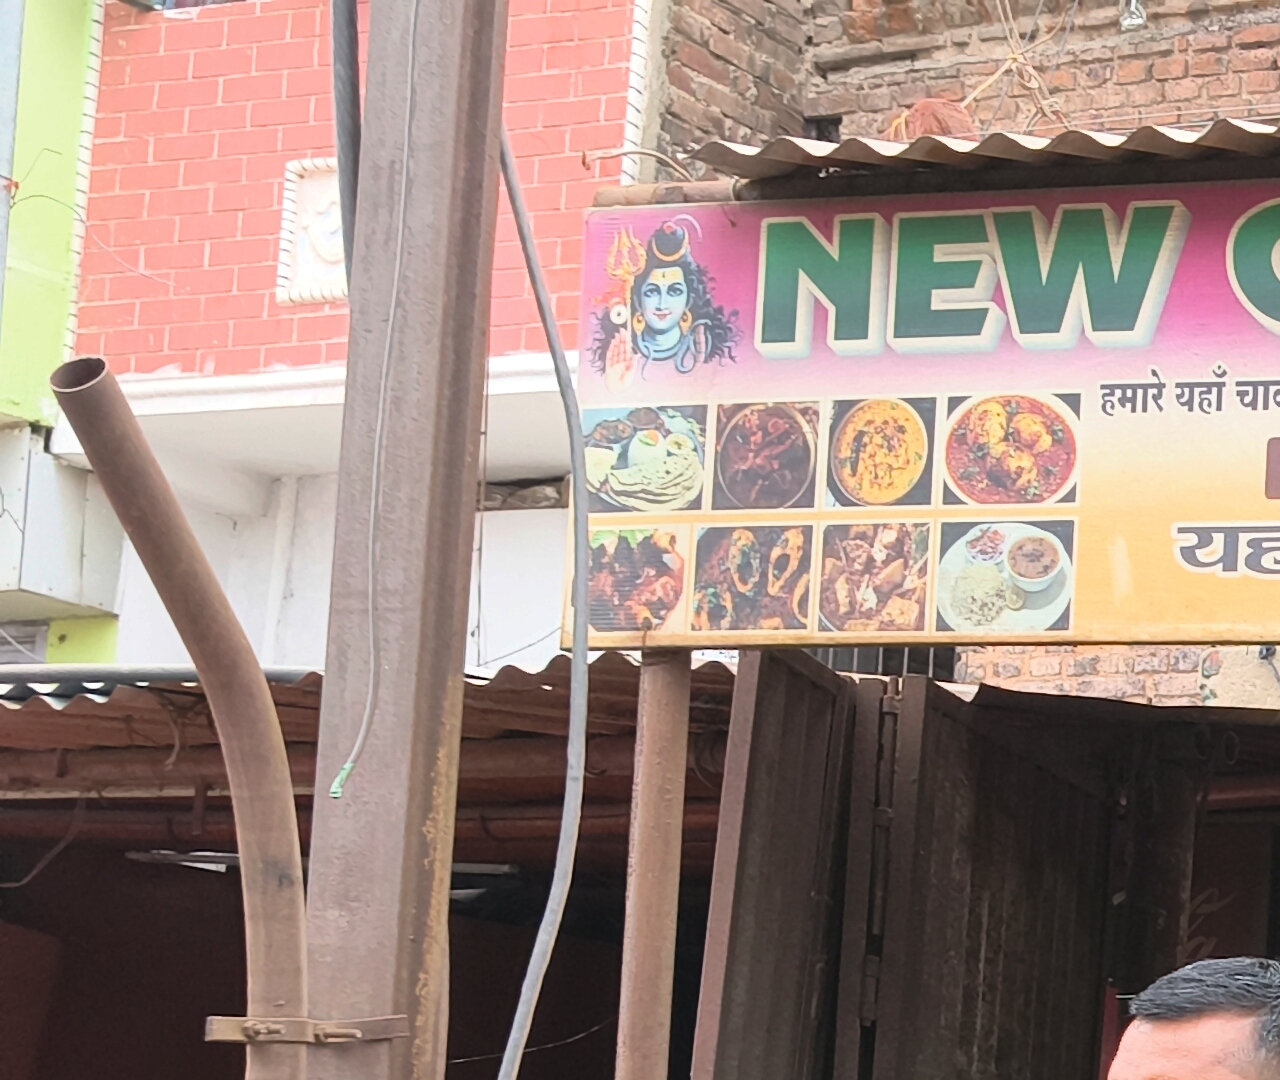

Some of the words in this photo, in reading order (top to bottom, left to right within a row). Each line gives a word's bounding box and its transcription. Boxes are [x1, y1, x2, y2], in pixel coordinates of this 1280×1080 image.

[757, 202, 1180, 350] NEW
[1100, 369, 1165, 416] हमारे
[1175, 363, 1227, 414] यहाँ
